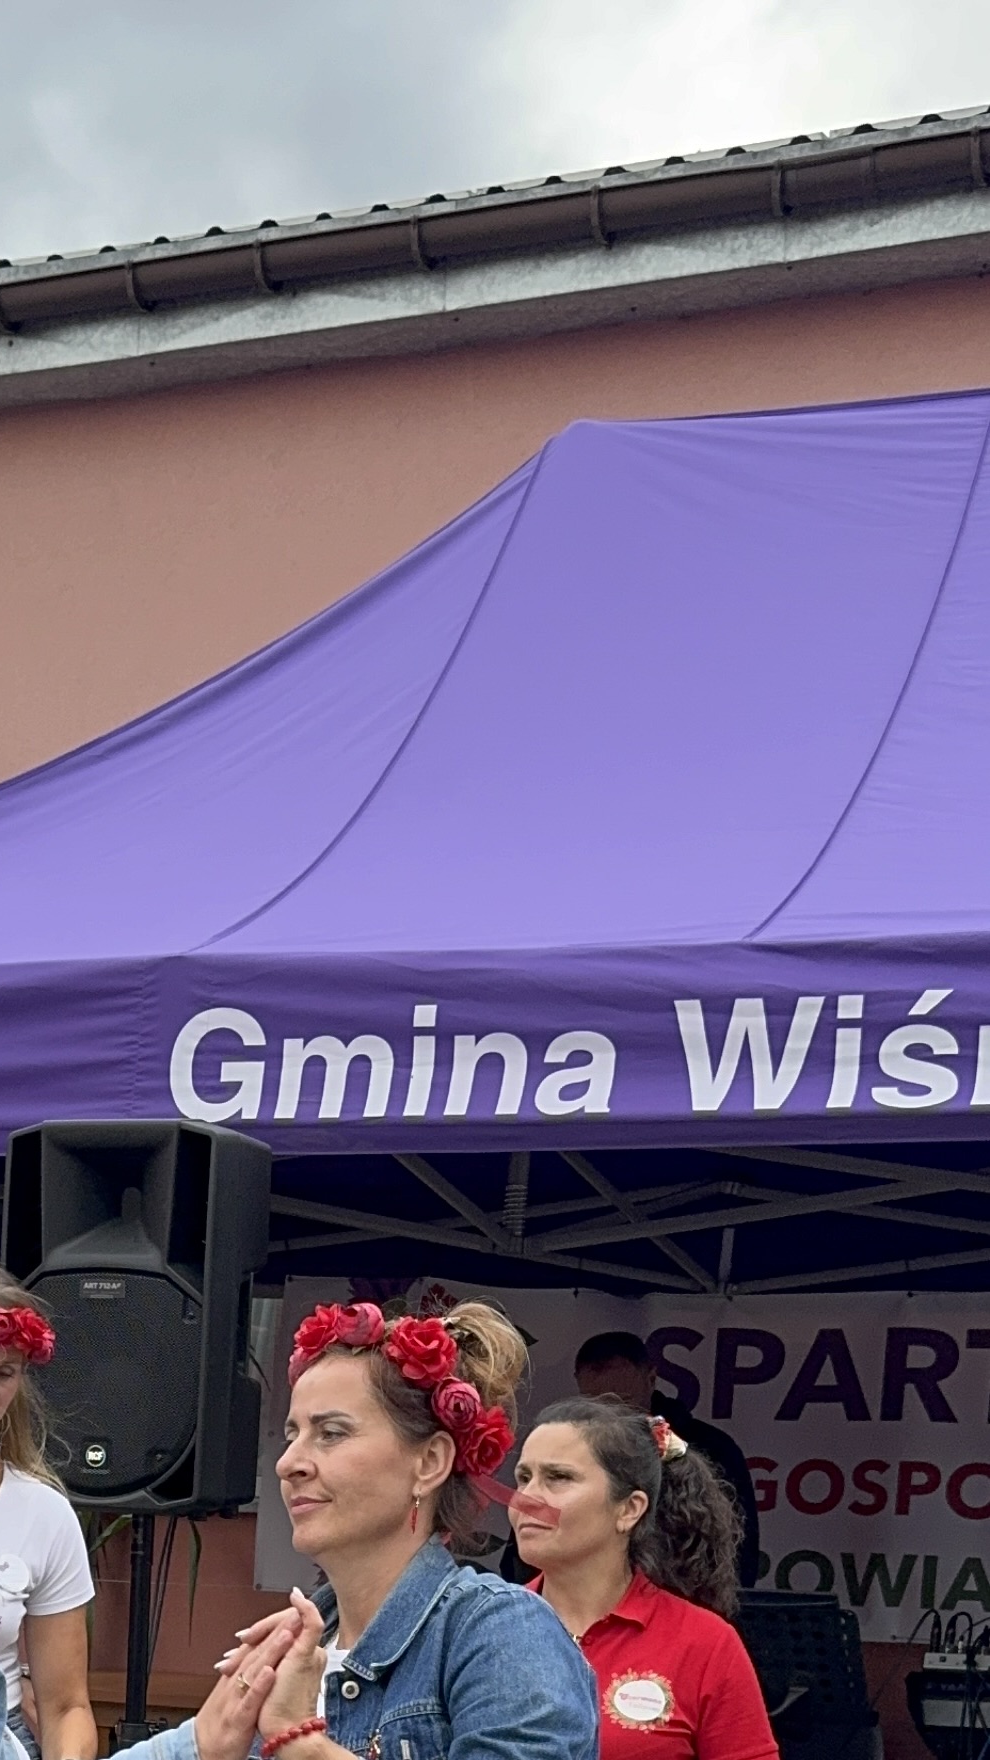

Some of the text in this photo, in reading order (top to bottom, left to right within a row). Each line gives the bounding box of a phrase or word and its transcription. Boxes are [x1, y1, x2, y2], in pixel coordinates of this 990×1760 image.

[168, 988, 990, 1122] Gmina Wiś
[646, 1326, 990, 1423] SPAR
[744, 1456, 990, 1520] GOSPO
